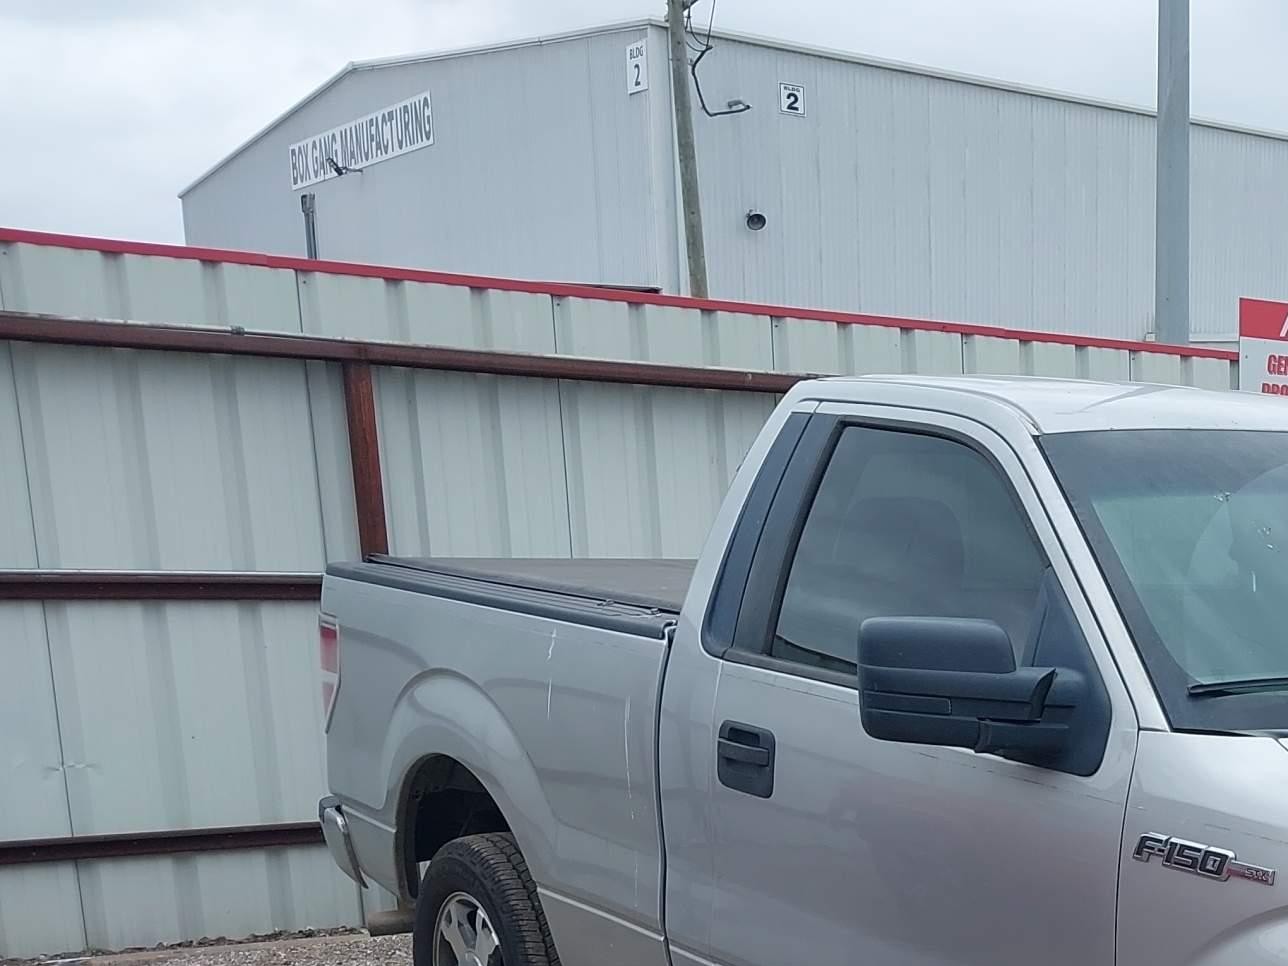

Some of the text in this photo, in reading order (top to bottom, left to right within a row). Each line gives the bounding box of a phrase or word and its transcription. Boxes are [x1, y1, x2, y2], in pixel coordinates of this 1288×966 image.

[629, 45, 644, 60] BLDG
[633, 63, 642, 87] 2
[783, 85, 801, 93] BLDG
[786, 92, 799, 111] 2
[290, 95, 432, 185] BOX GANG MANUFACTURING
[1133, 832, 1232, 881] F-150
